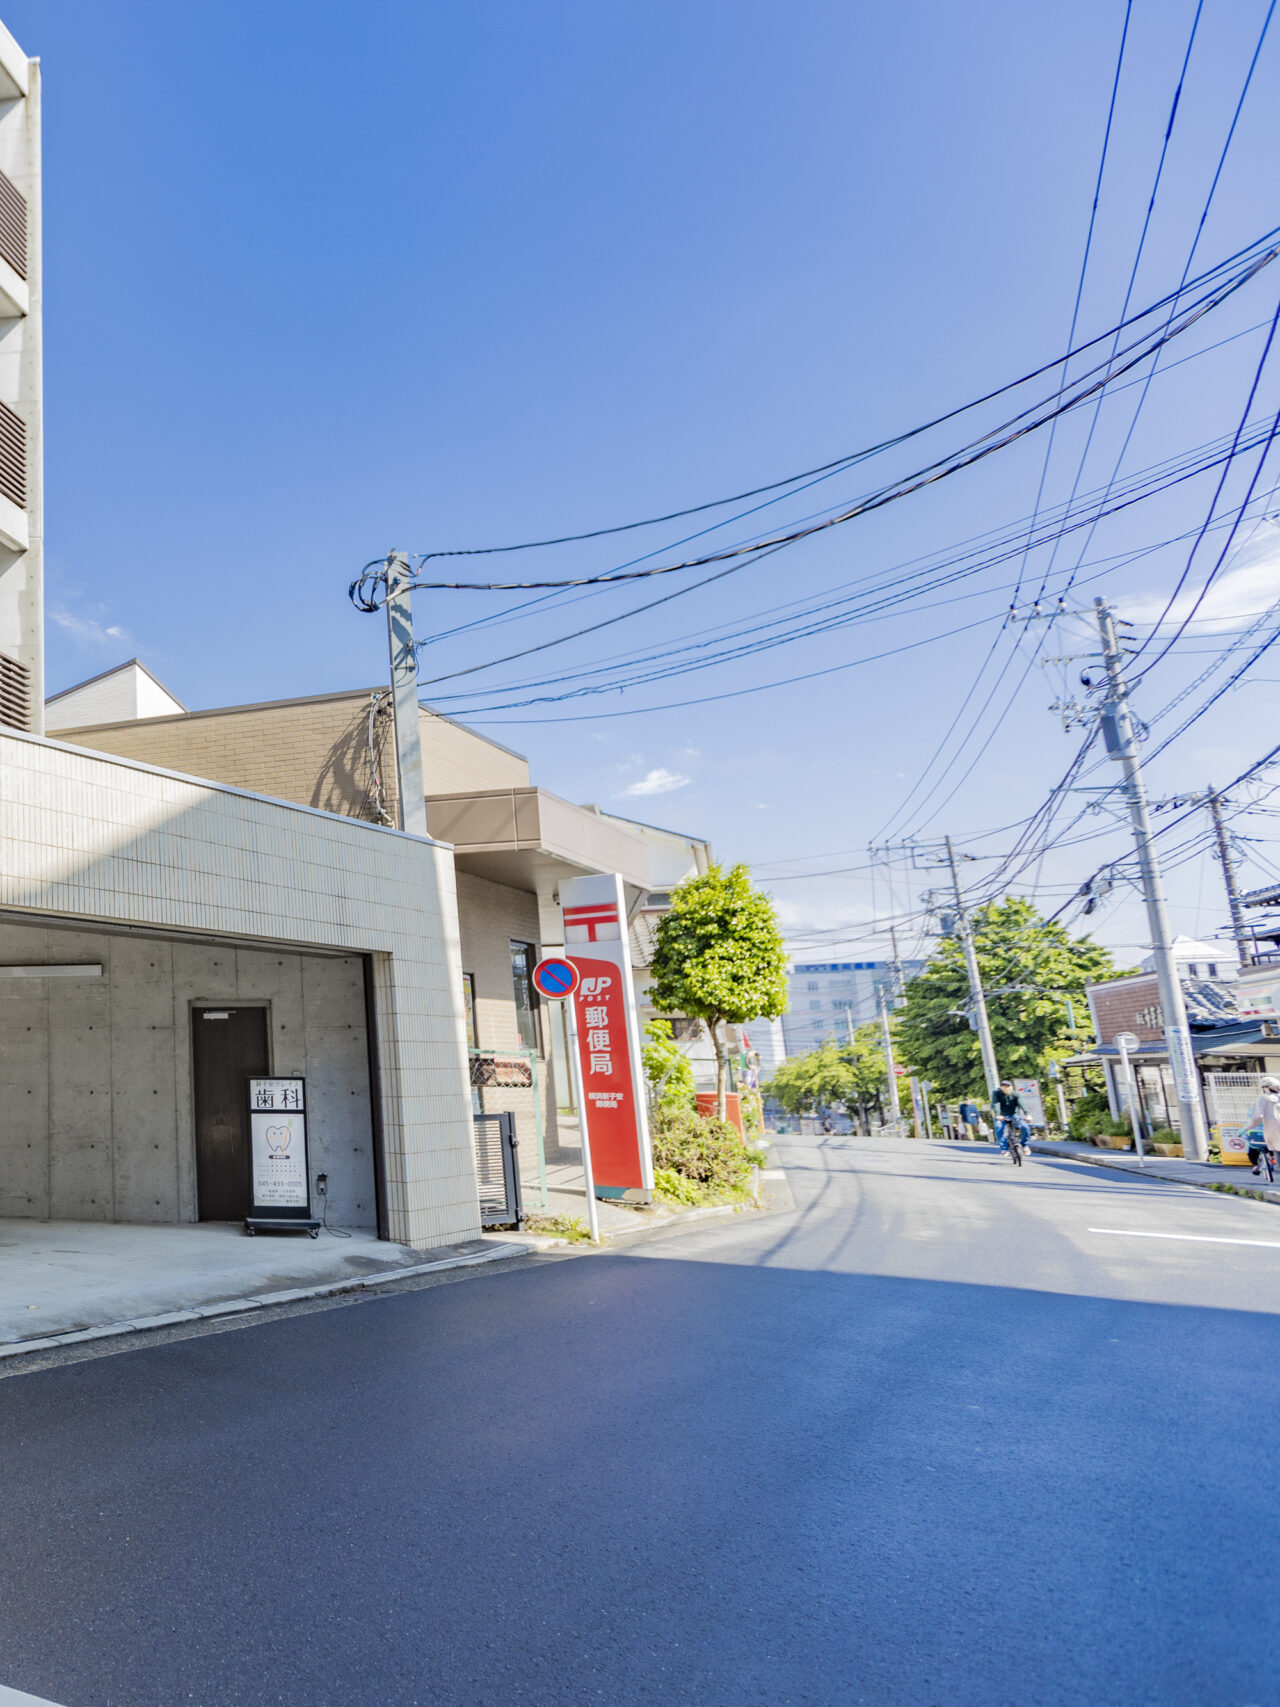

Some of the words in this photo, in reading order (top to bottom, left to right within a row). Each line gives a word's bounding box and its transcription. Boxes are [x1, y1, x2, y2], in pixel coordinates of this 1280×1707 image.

[580, 977, 612, 996] JP
[585, 1006, 613, 1076] 郵便局
[255, 1088, 301, 1109] 歯科
